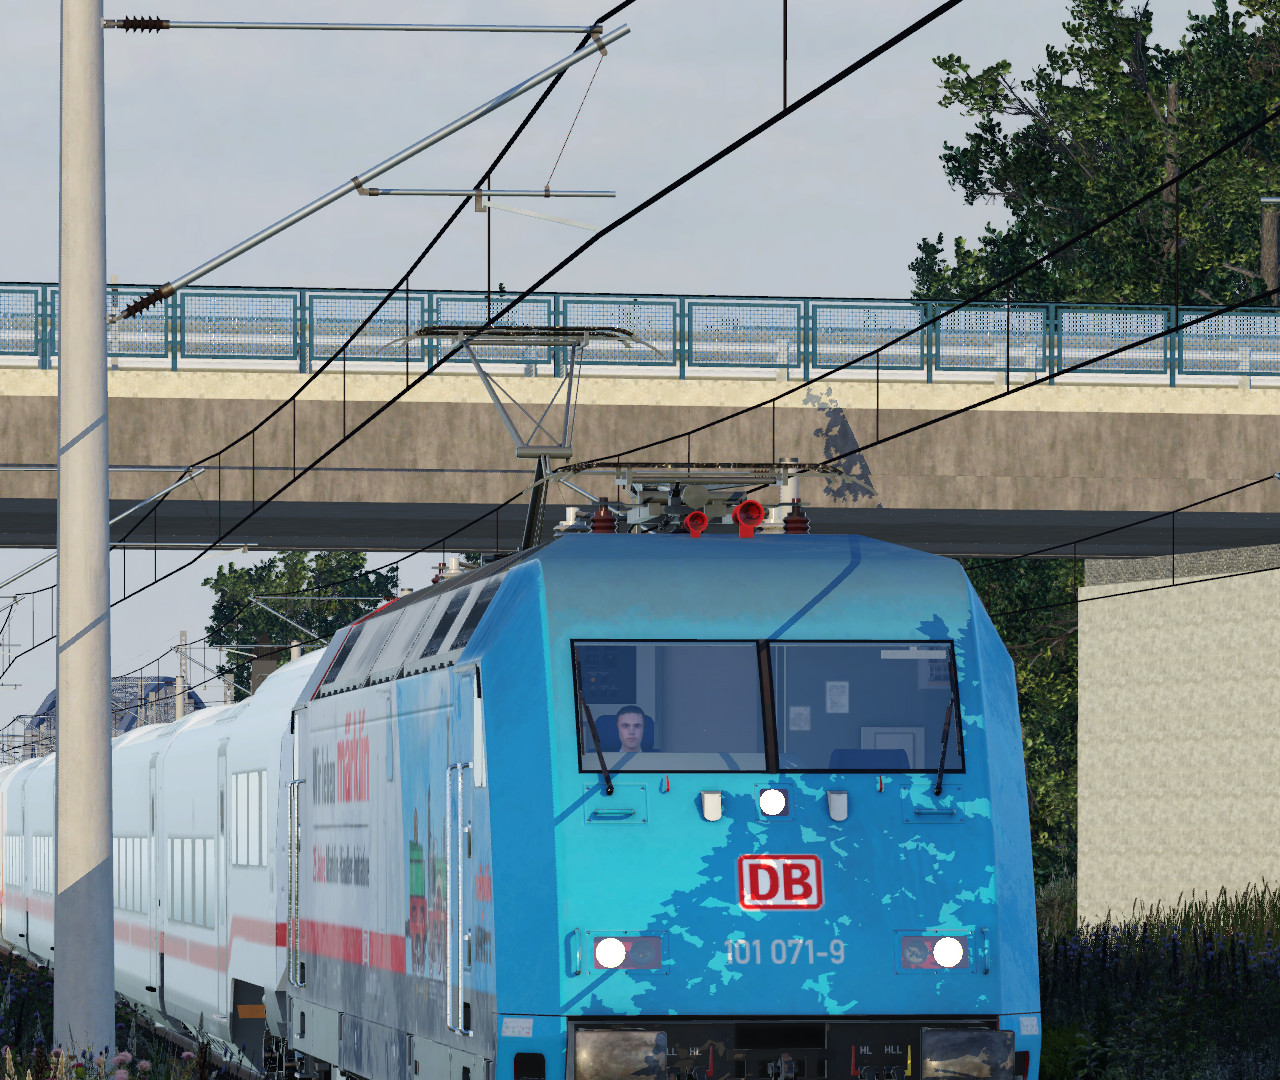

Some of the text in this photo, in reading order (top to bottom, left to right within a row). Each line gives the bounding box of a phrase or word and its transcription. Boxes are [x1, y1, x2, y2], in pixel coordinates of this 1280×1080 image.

[337, 707, 368, 804] märklin
[748, 863, 813, 901] DB
[724, 939, 845, 965] 101 071-9
[689, 1046, 702, 1056] HL
[859, 1044, 903, 1055] HL HLL
